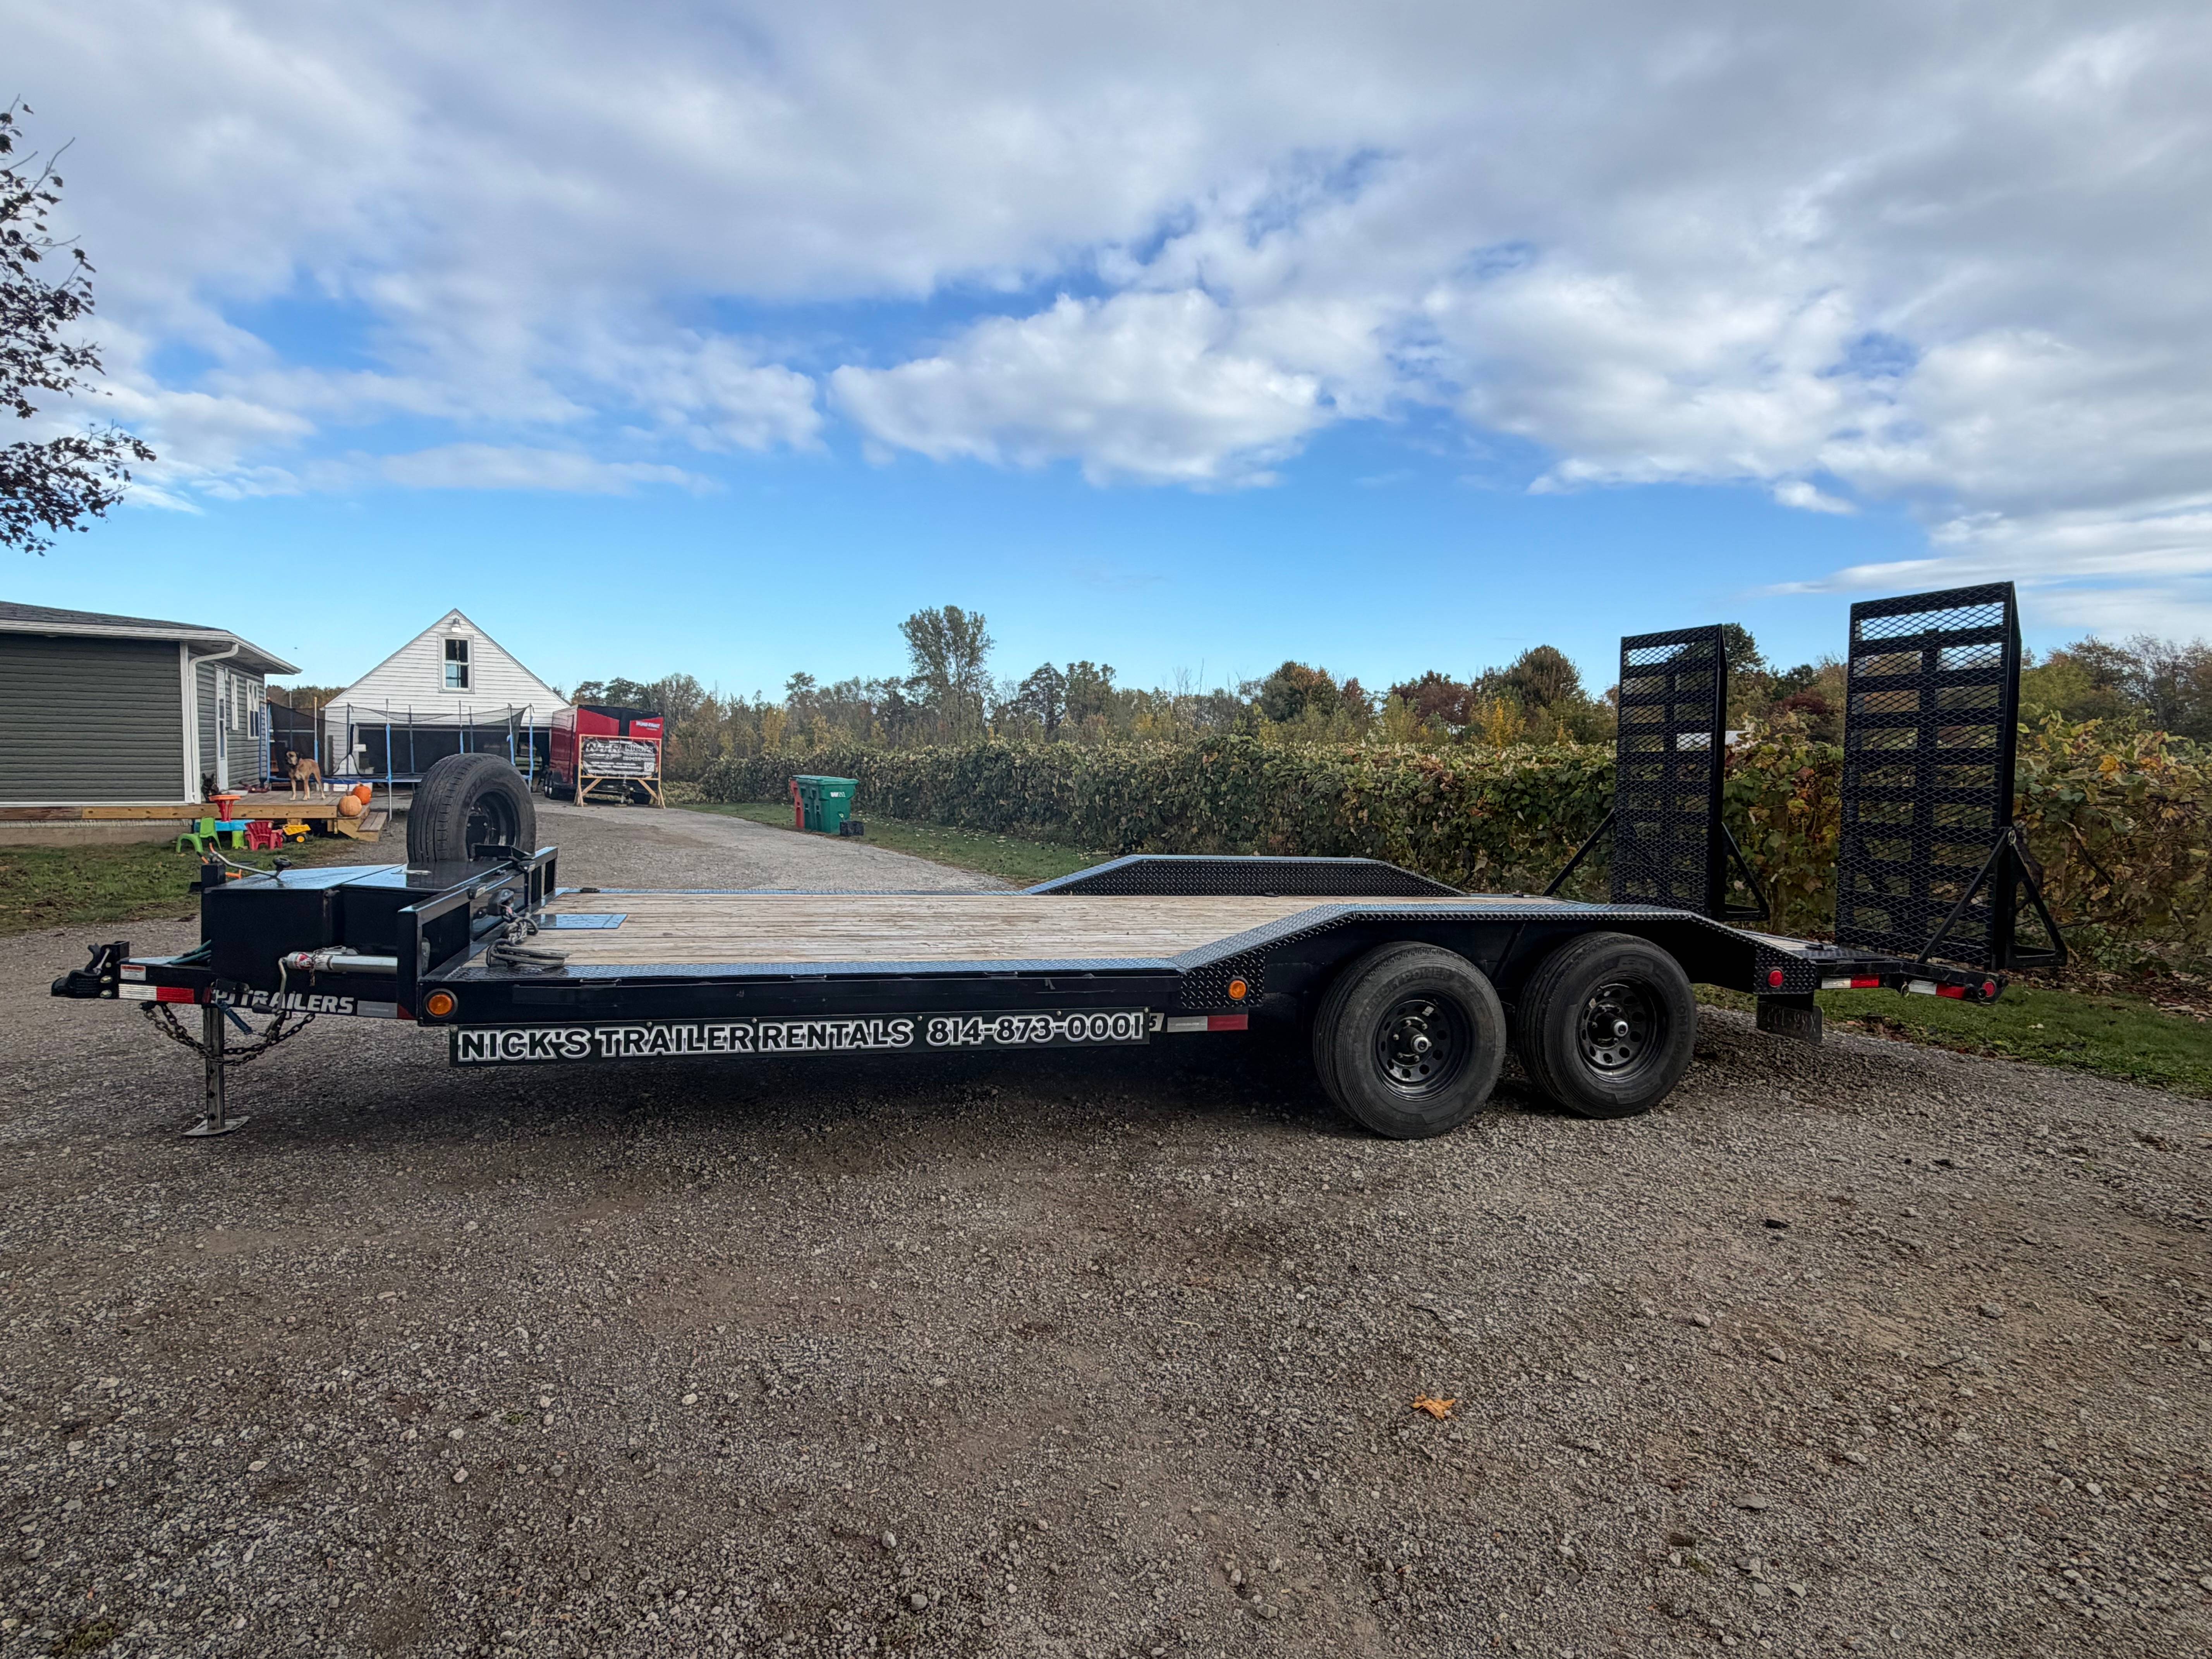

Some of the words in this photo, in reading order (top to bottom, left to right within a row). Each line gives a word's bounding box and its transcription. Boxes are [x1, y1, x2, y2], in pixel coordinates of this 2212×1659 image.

[239, 990, 354, 1014] TRAILERS
[458, 1027, 591, 1061] NICK'S
[595, 1024, 755, 1056] TRAILER
[759, 1019, 913, 1052] RENTALS
[927, 1012, 1142, 1044] 814-873-0001
